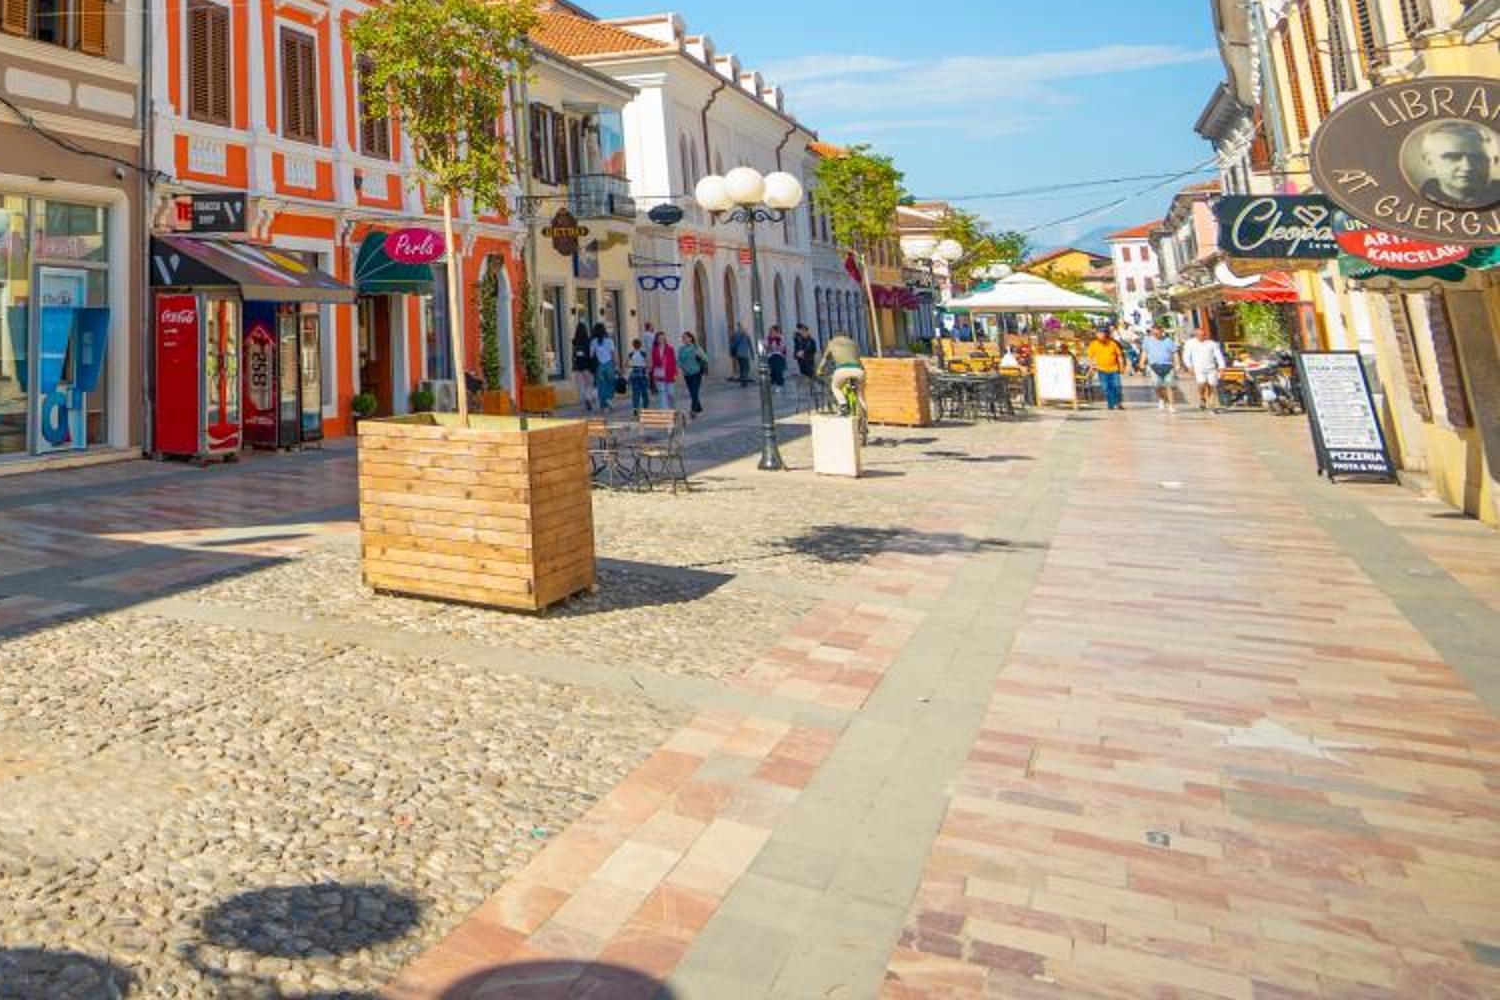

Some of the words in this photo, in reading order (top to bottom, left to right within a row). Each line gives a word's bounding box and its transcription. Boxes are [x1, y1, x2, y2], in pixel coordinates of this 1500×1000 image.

[1369, 86, 1500, 127] LIBRA
[1332, 168, 1379, 194] AT
[1331, 450, 1384, 463] PIZZERIA
